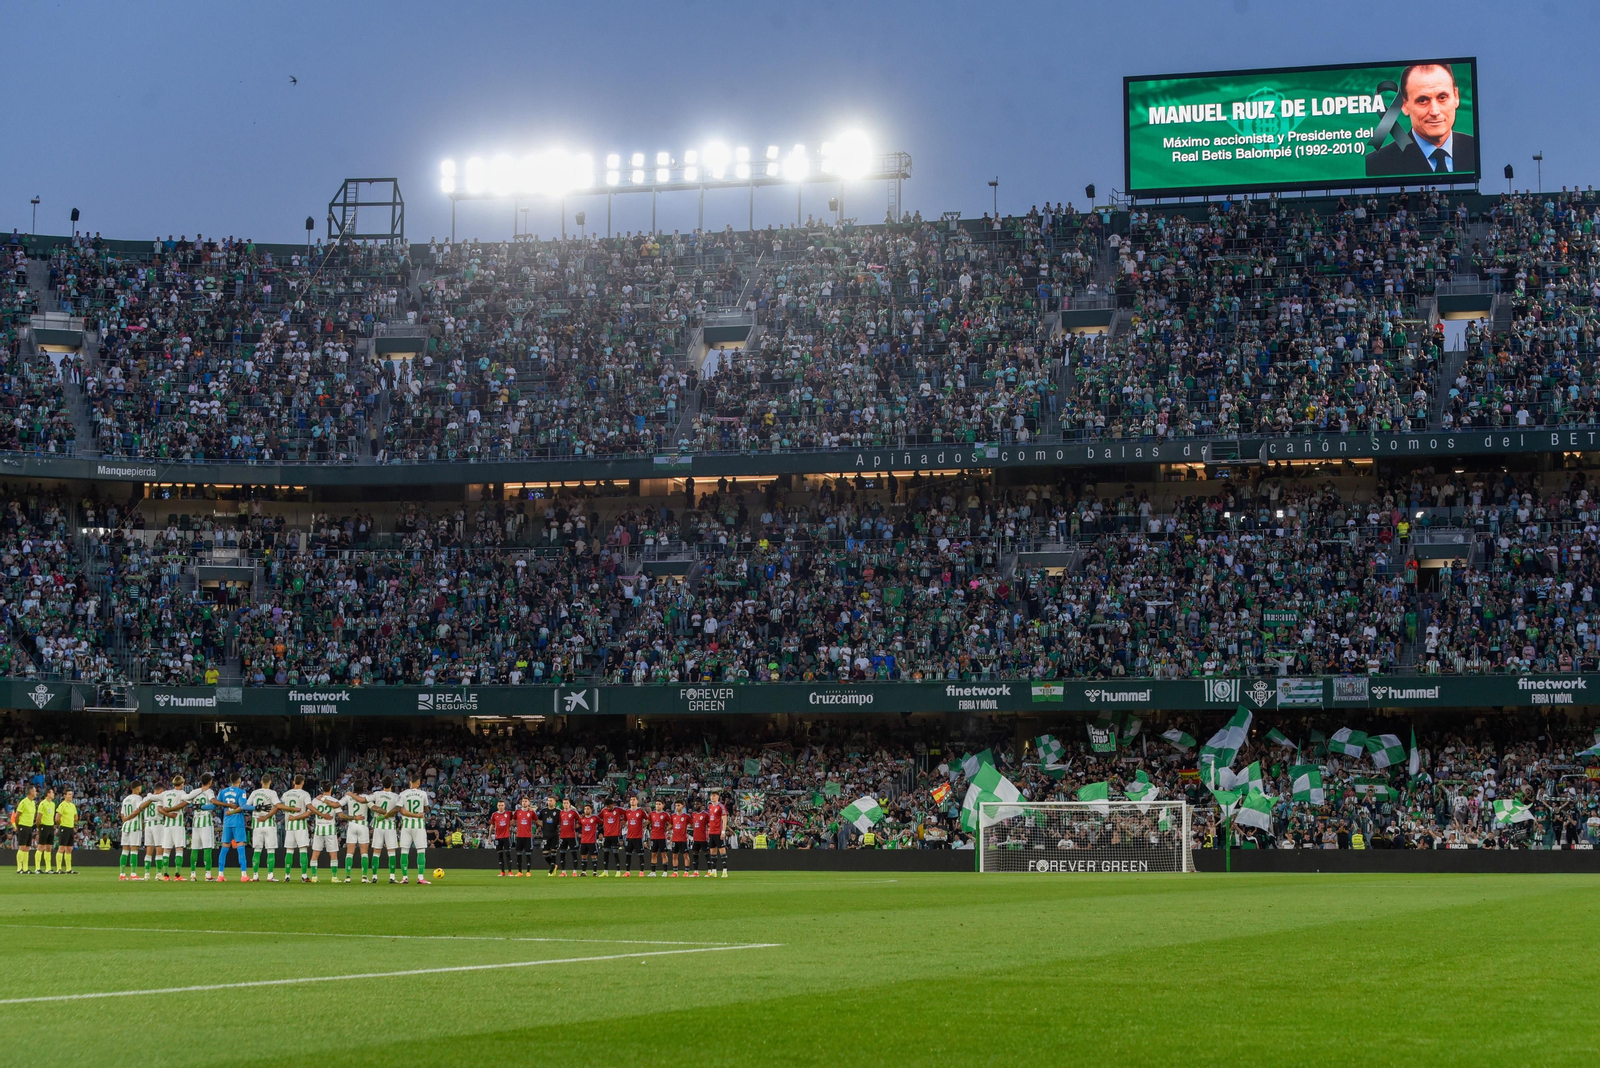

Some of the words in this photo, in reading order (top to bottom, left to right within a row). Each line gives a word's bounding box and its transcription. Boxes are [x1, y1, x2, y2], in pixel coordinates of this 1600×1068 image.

[1149, 103, 1227, 124] MANUEL
[1232, 101, 1275, 120] RUIZ
[1281, 99, 1306, 118] DE
[1311, 94, 1386, 116] LOPERA
[1163, 136, 1210, 149] Máximo
[1213, 132, 1274, 146] accionista
[1277, 134, 1284, 146] y
[1287, 128, 1352, 143] Presidente
[1355, 127, 1374, 139] del
[1172, 151, 1198, 162] Real
[1202, 149, 1232, 160] Betis
[1236, 144, 1292, 160] Balompié
[1295, 142, 1365, 158] (1992-2010)
[856, 451, 978, 468] Apiñados
[1001, 449, 1063, 462] como
[1087, 445, 1159, 459] balas
[1484, 433, 1524, 448] del
[1551, 432, 1596, 446] BET
[97, 465, 157, 477] Manquepierda
[1517, 677, 1587, 690] finetwork
[288, 690, 350, 701] finetwork
[946, 684, 1011, 697] finetwork
[1101, 689, 1151, 702] hummel
[1388, 686, 1440, 699] hummel
[170, 694, 216, 707] hummel
[809, 691, 874, 706] Cruzcampo
[958, 700, 975, 710] FIBRA
[980, 698, 998, 710] MÓVIL
[1531, 694, 1549, 704] FIBRA
[1554, 692, 1573, 704] MÓVIL
[300, 704, 317, 714] FIBRA
[321, 703, 338, 714] MÓVIL
[689, 700, 725, 711] GREEN
[407, 799, 421, 814] 12
[1028, 859, 1096, 873] FOREVER
[1101, 860, 1148, 873] GREEN
